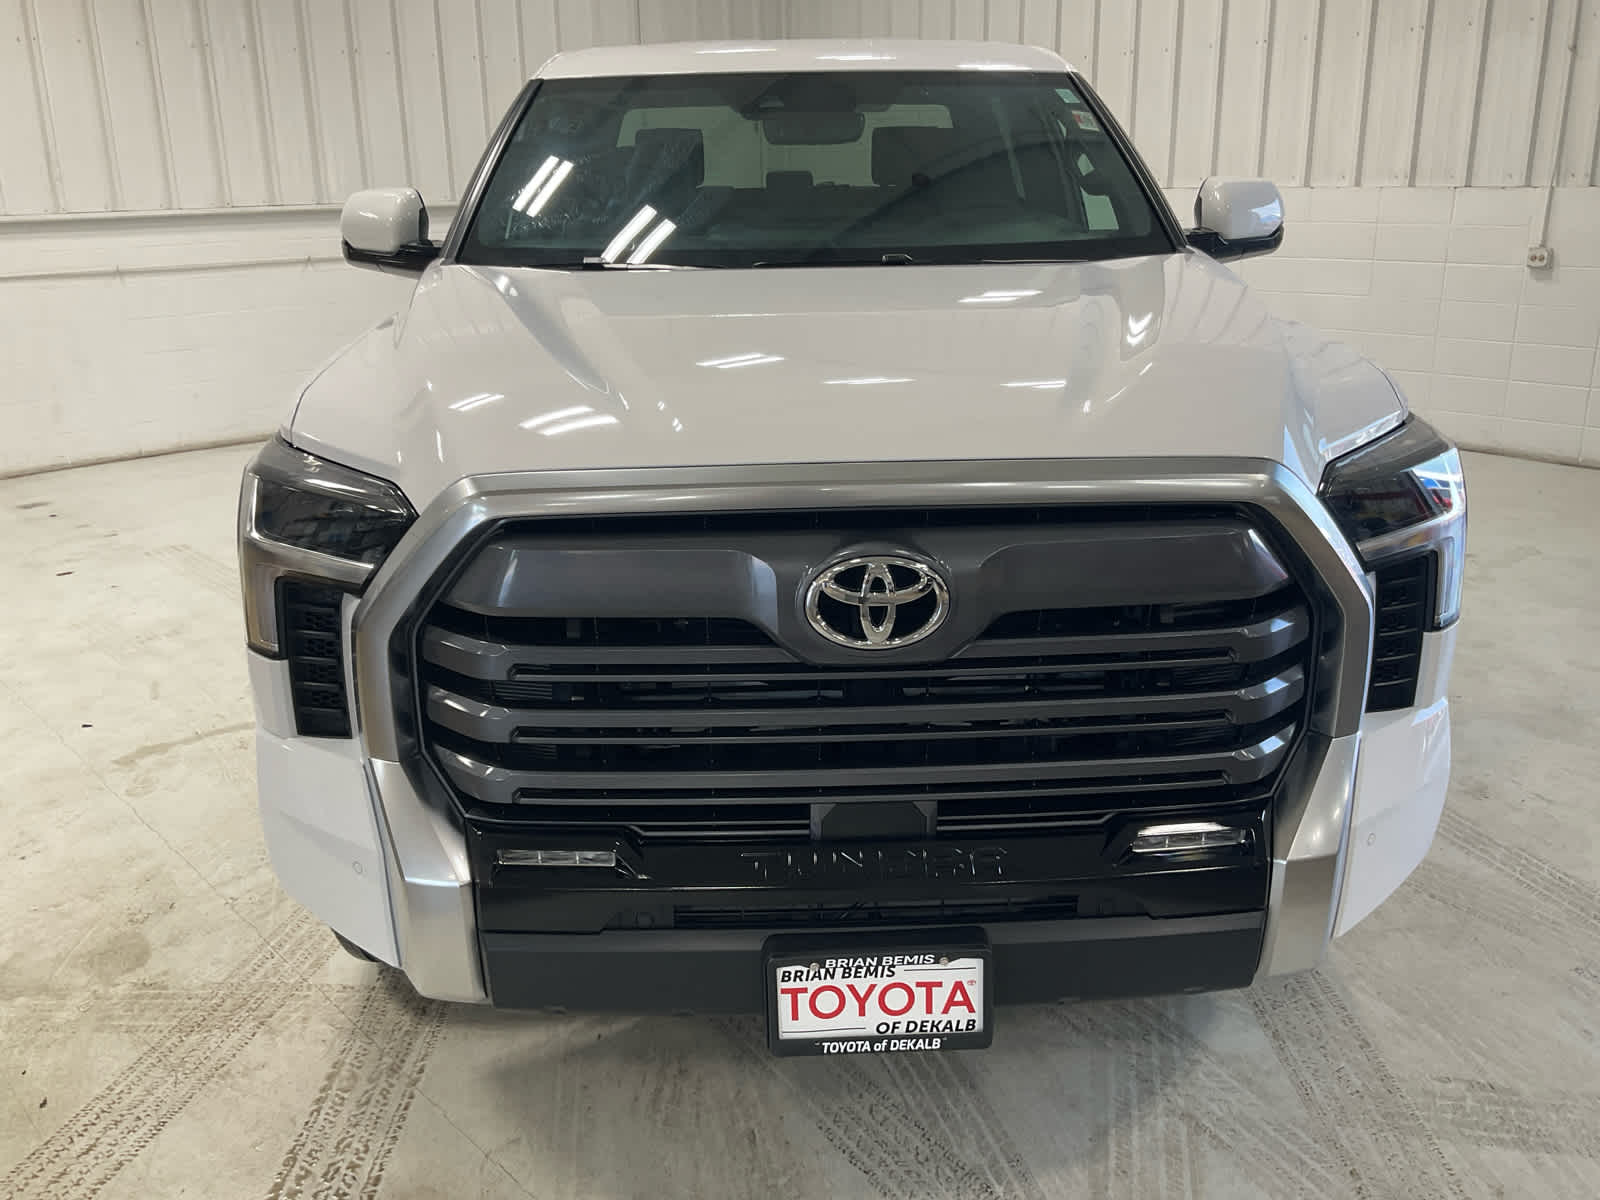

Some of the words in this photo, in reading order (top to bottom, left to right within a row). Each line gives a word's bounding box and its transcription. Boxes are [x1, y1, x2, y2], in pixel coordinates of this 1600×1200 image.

[825, 956, 879, 969] BRIAN
[882, 954, 935, 966] BEMIS
[781, 967, 835, 983] BRIAN
[841, 966, 896, 979] BEMIS
[780, 980, 976, 1021] TOYOTA
[876, 1022, 901, 1035] OF
[905, 1019, 977, 1034] DEKALB
[822, 1041, 871, 1054] TOYOTA
[874, 1041, 888, 1053] of
[890, 1038, 941, 1051] DEKALB
